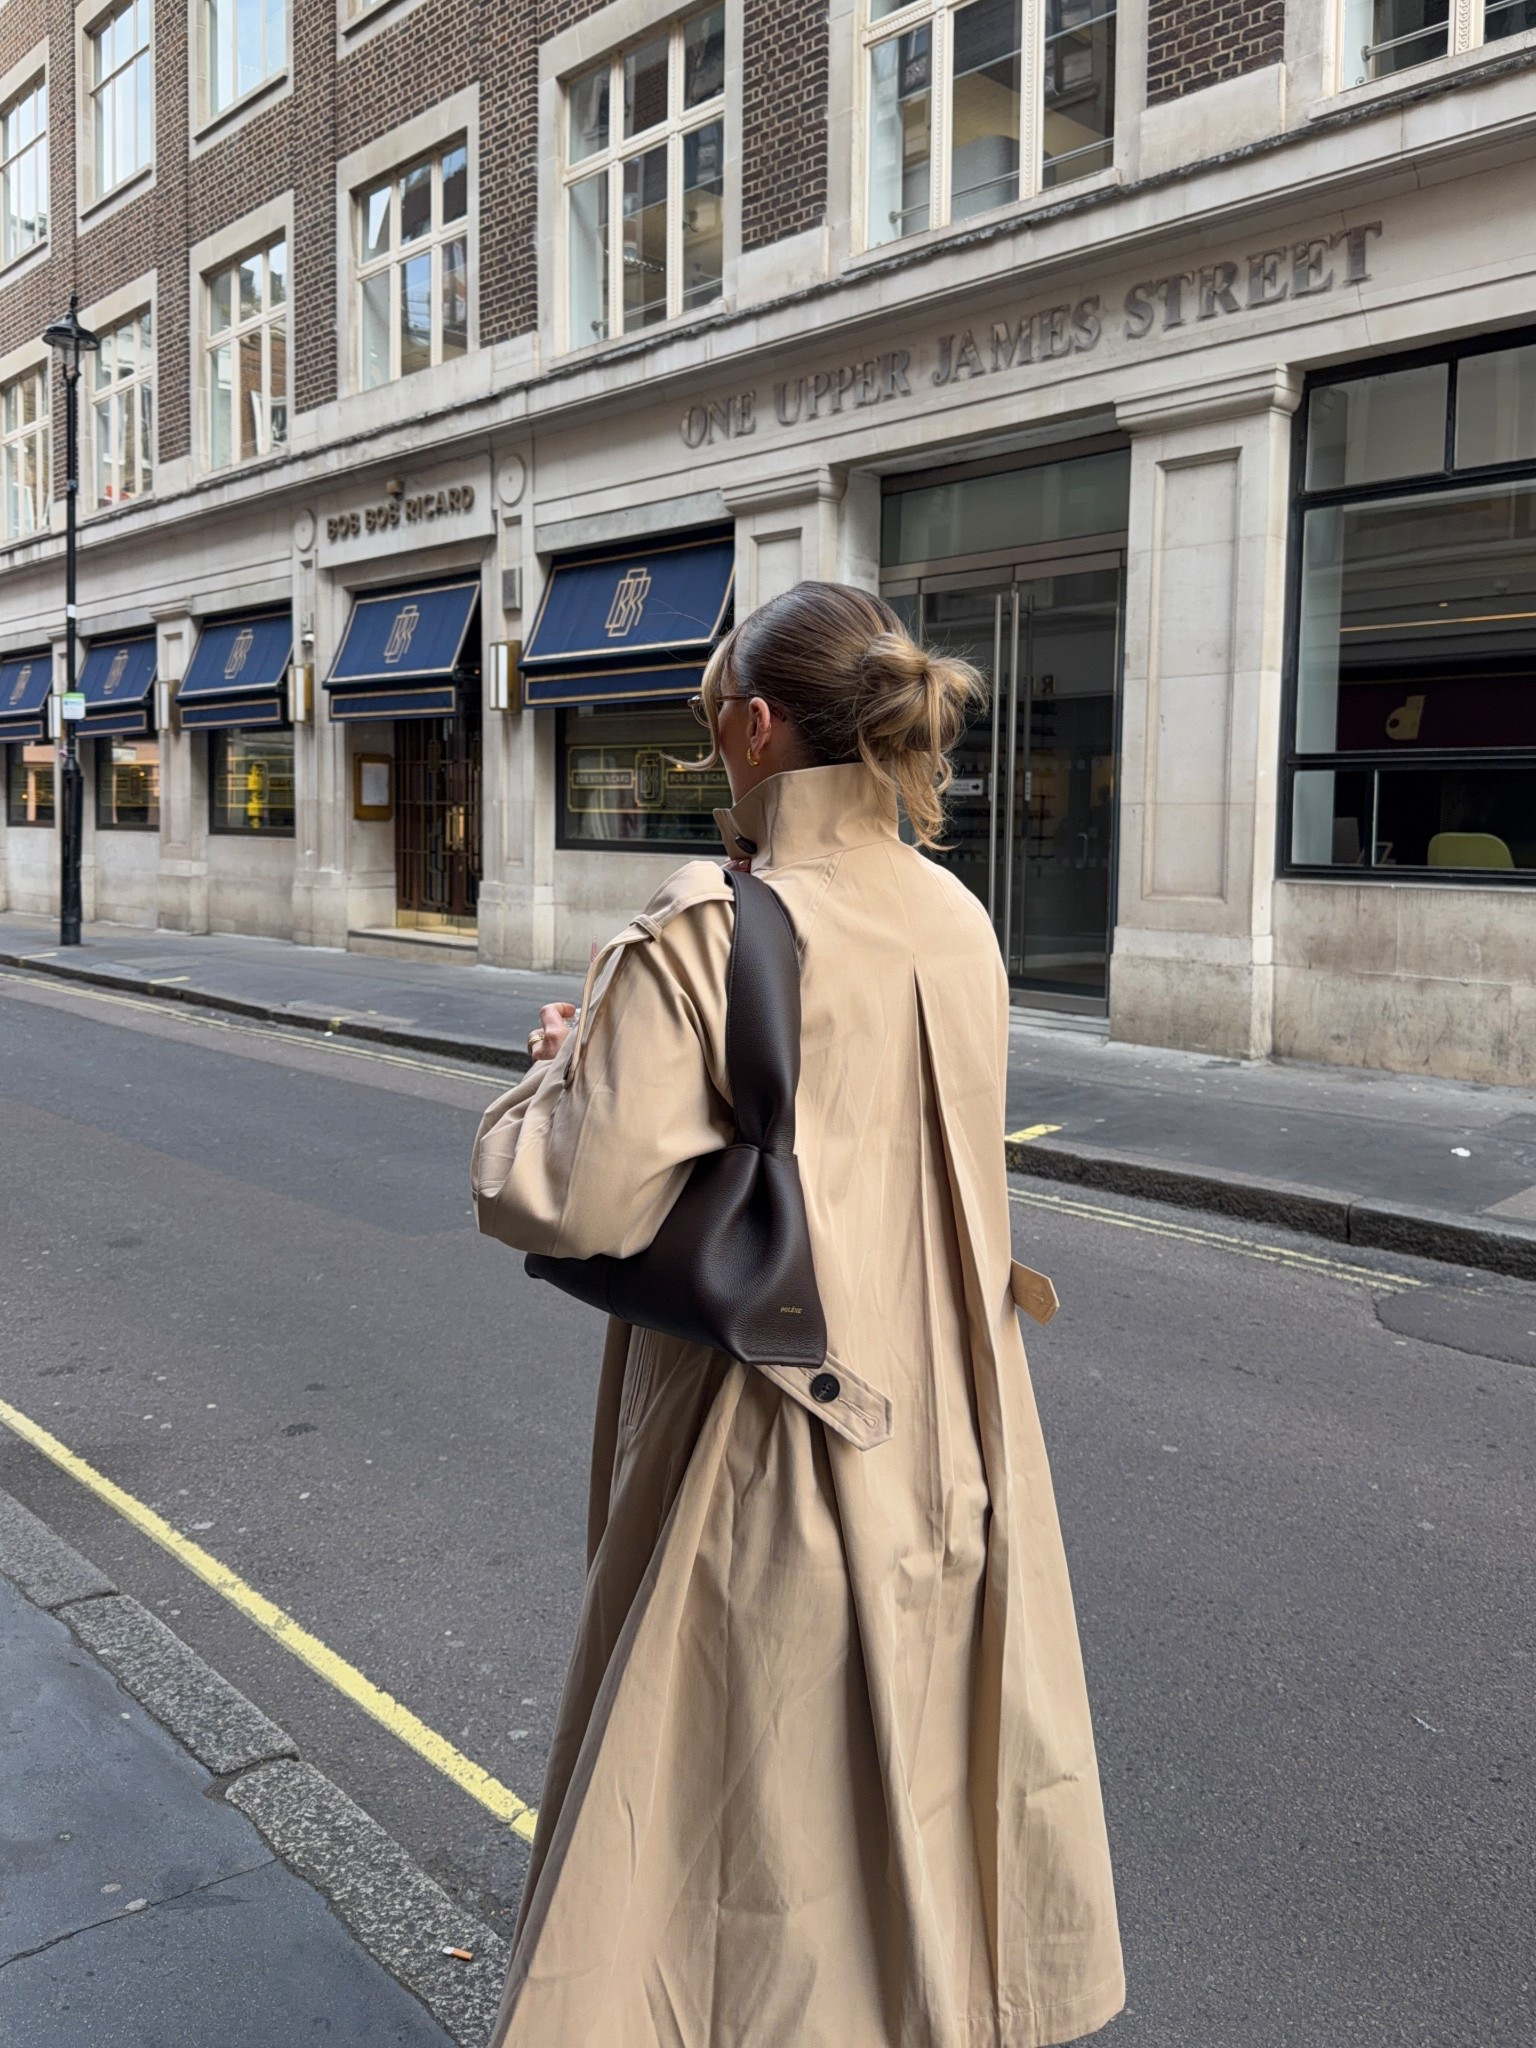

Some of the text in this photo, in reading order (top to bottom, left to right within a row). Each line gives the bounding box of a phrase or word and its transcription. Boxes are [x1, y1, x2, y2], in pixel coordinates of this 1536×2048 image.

[680, 221, 1383, 449] ONE UPPER JAMES STREET
[327, 485, 475, 541] BOB BOB RICARD
